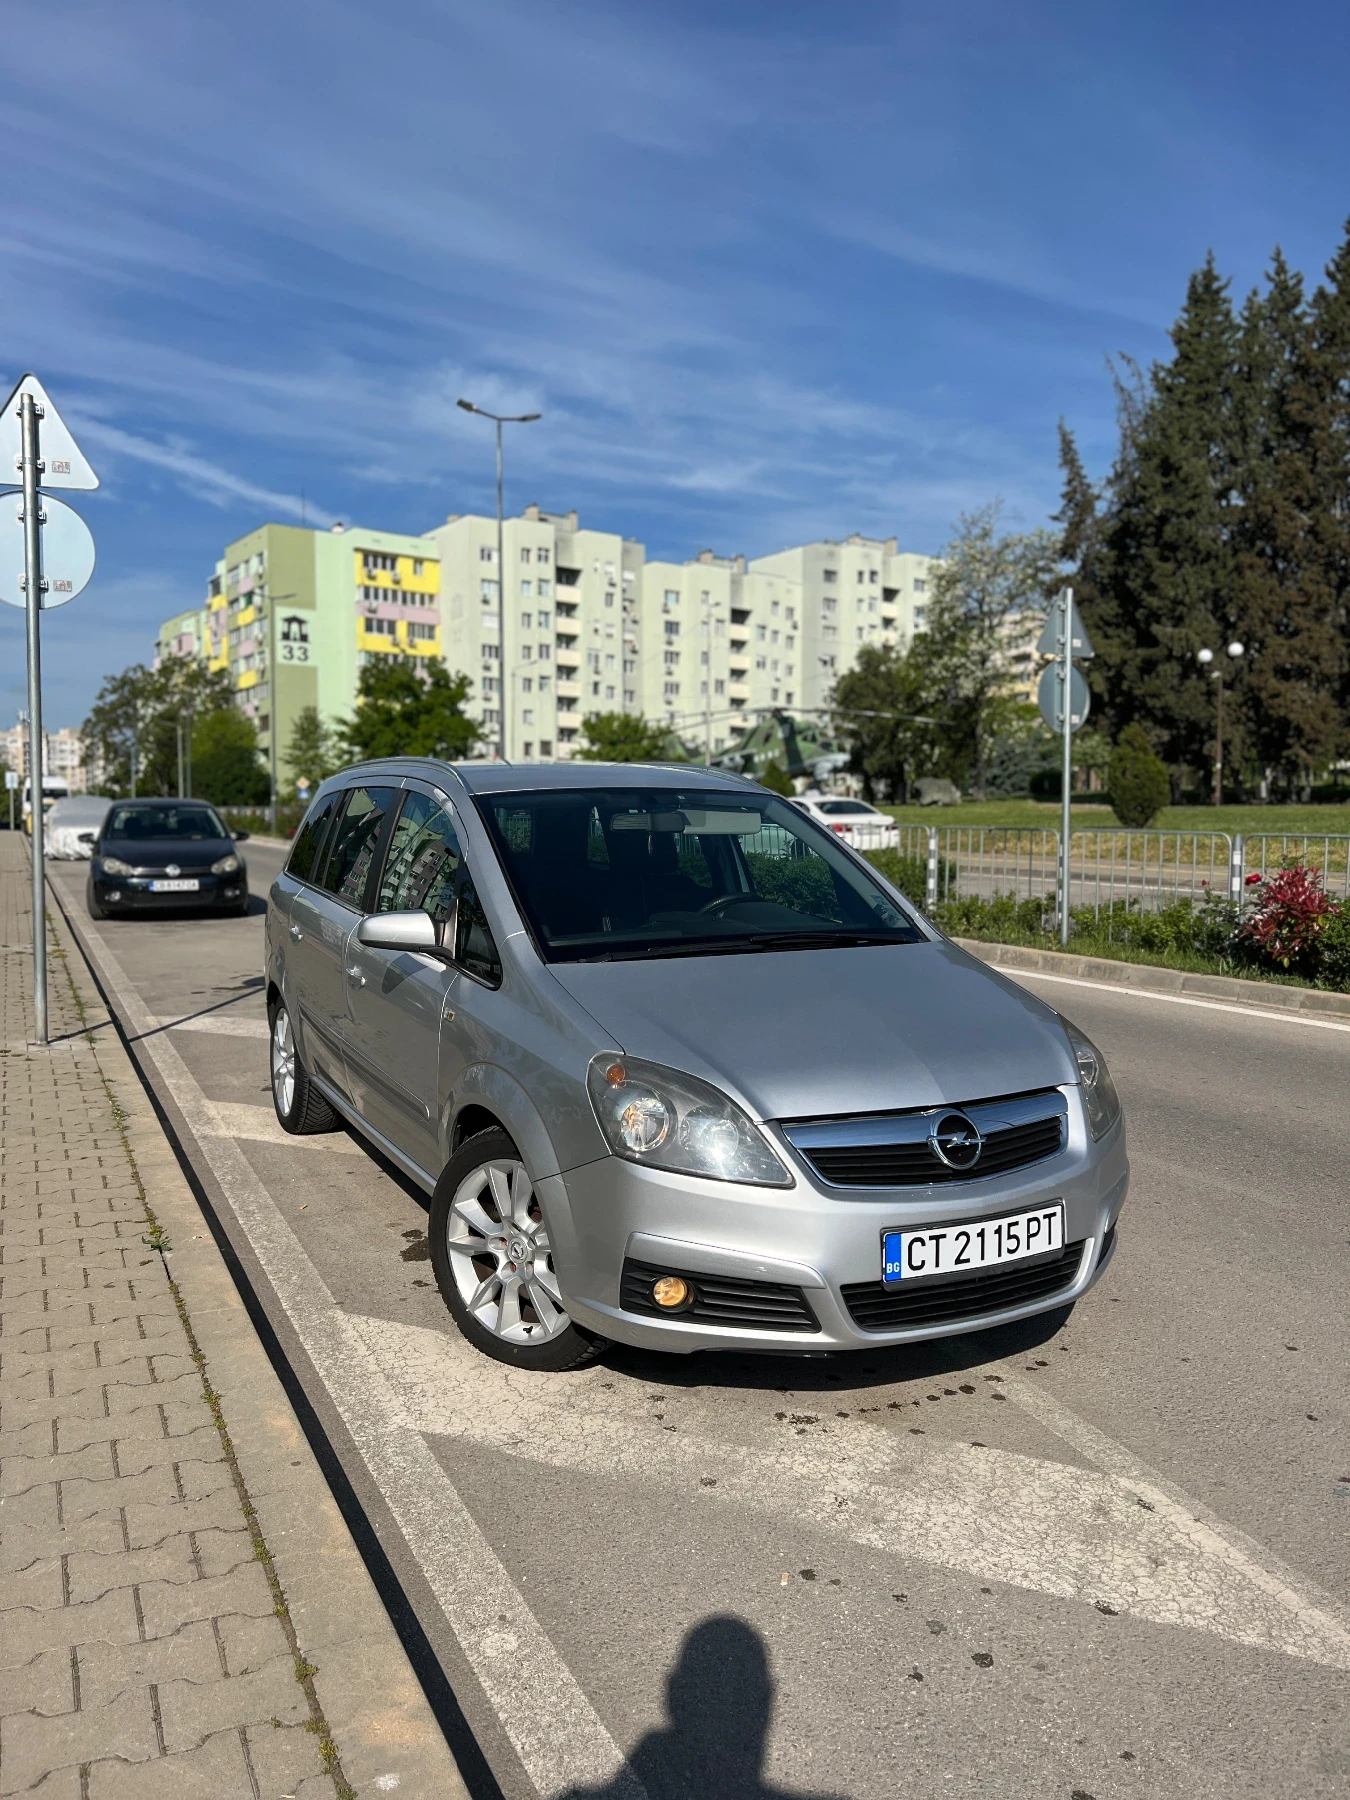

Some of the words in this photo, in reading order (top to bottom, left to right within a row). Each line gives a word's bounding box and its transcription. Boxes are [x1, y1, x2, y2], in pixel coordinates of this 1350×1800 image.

[282, 644, 309, 662] 33
[907, 1233, 947, 1271] CT
[954, 1220, 1021, 1265] 2115
[1026, 1212, 1057, 1250] PT
[886, 1262, 900, 1274] BG
